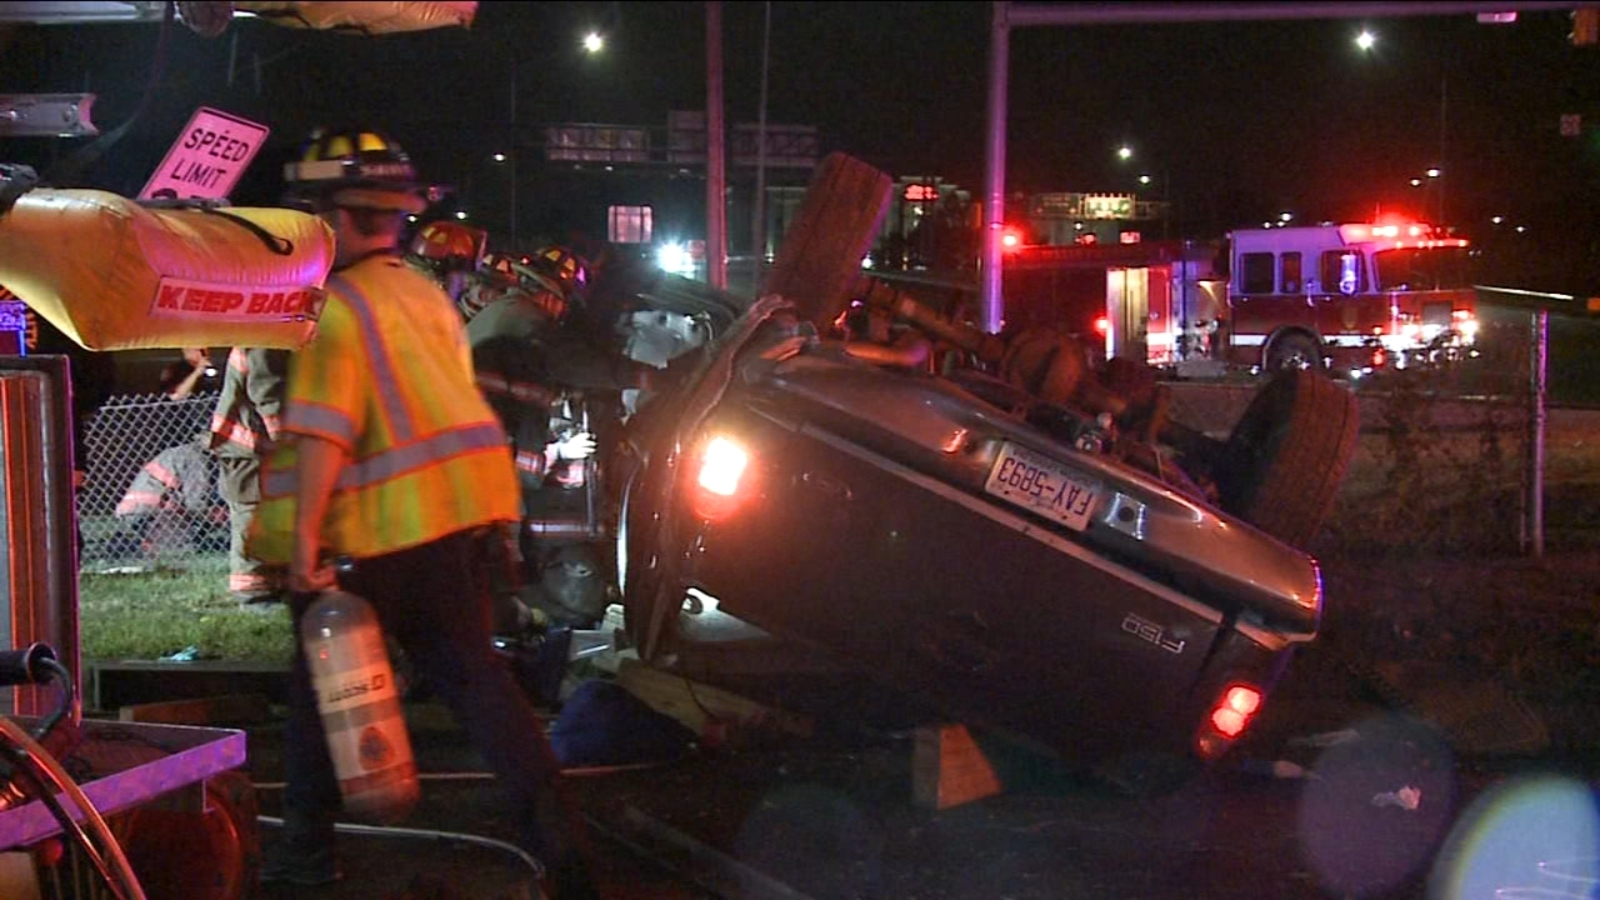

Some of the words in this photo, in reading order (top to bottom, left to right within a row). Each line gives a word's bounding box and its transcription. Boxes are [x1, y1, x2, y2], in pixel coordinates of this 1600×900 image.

[184, 128, 249, 162] SPEED
[170, 158, 227, 189] LIMIT
[157, 285, 244, 313] KEEP
[997, 457, 1093, 516] FAY-5893
[1121, 617, 1185, 653] F150
